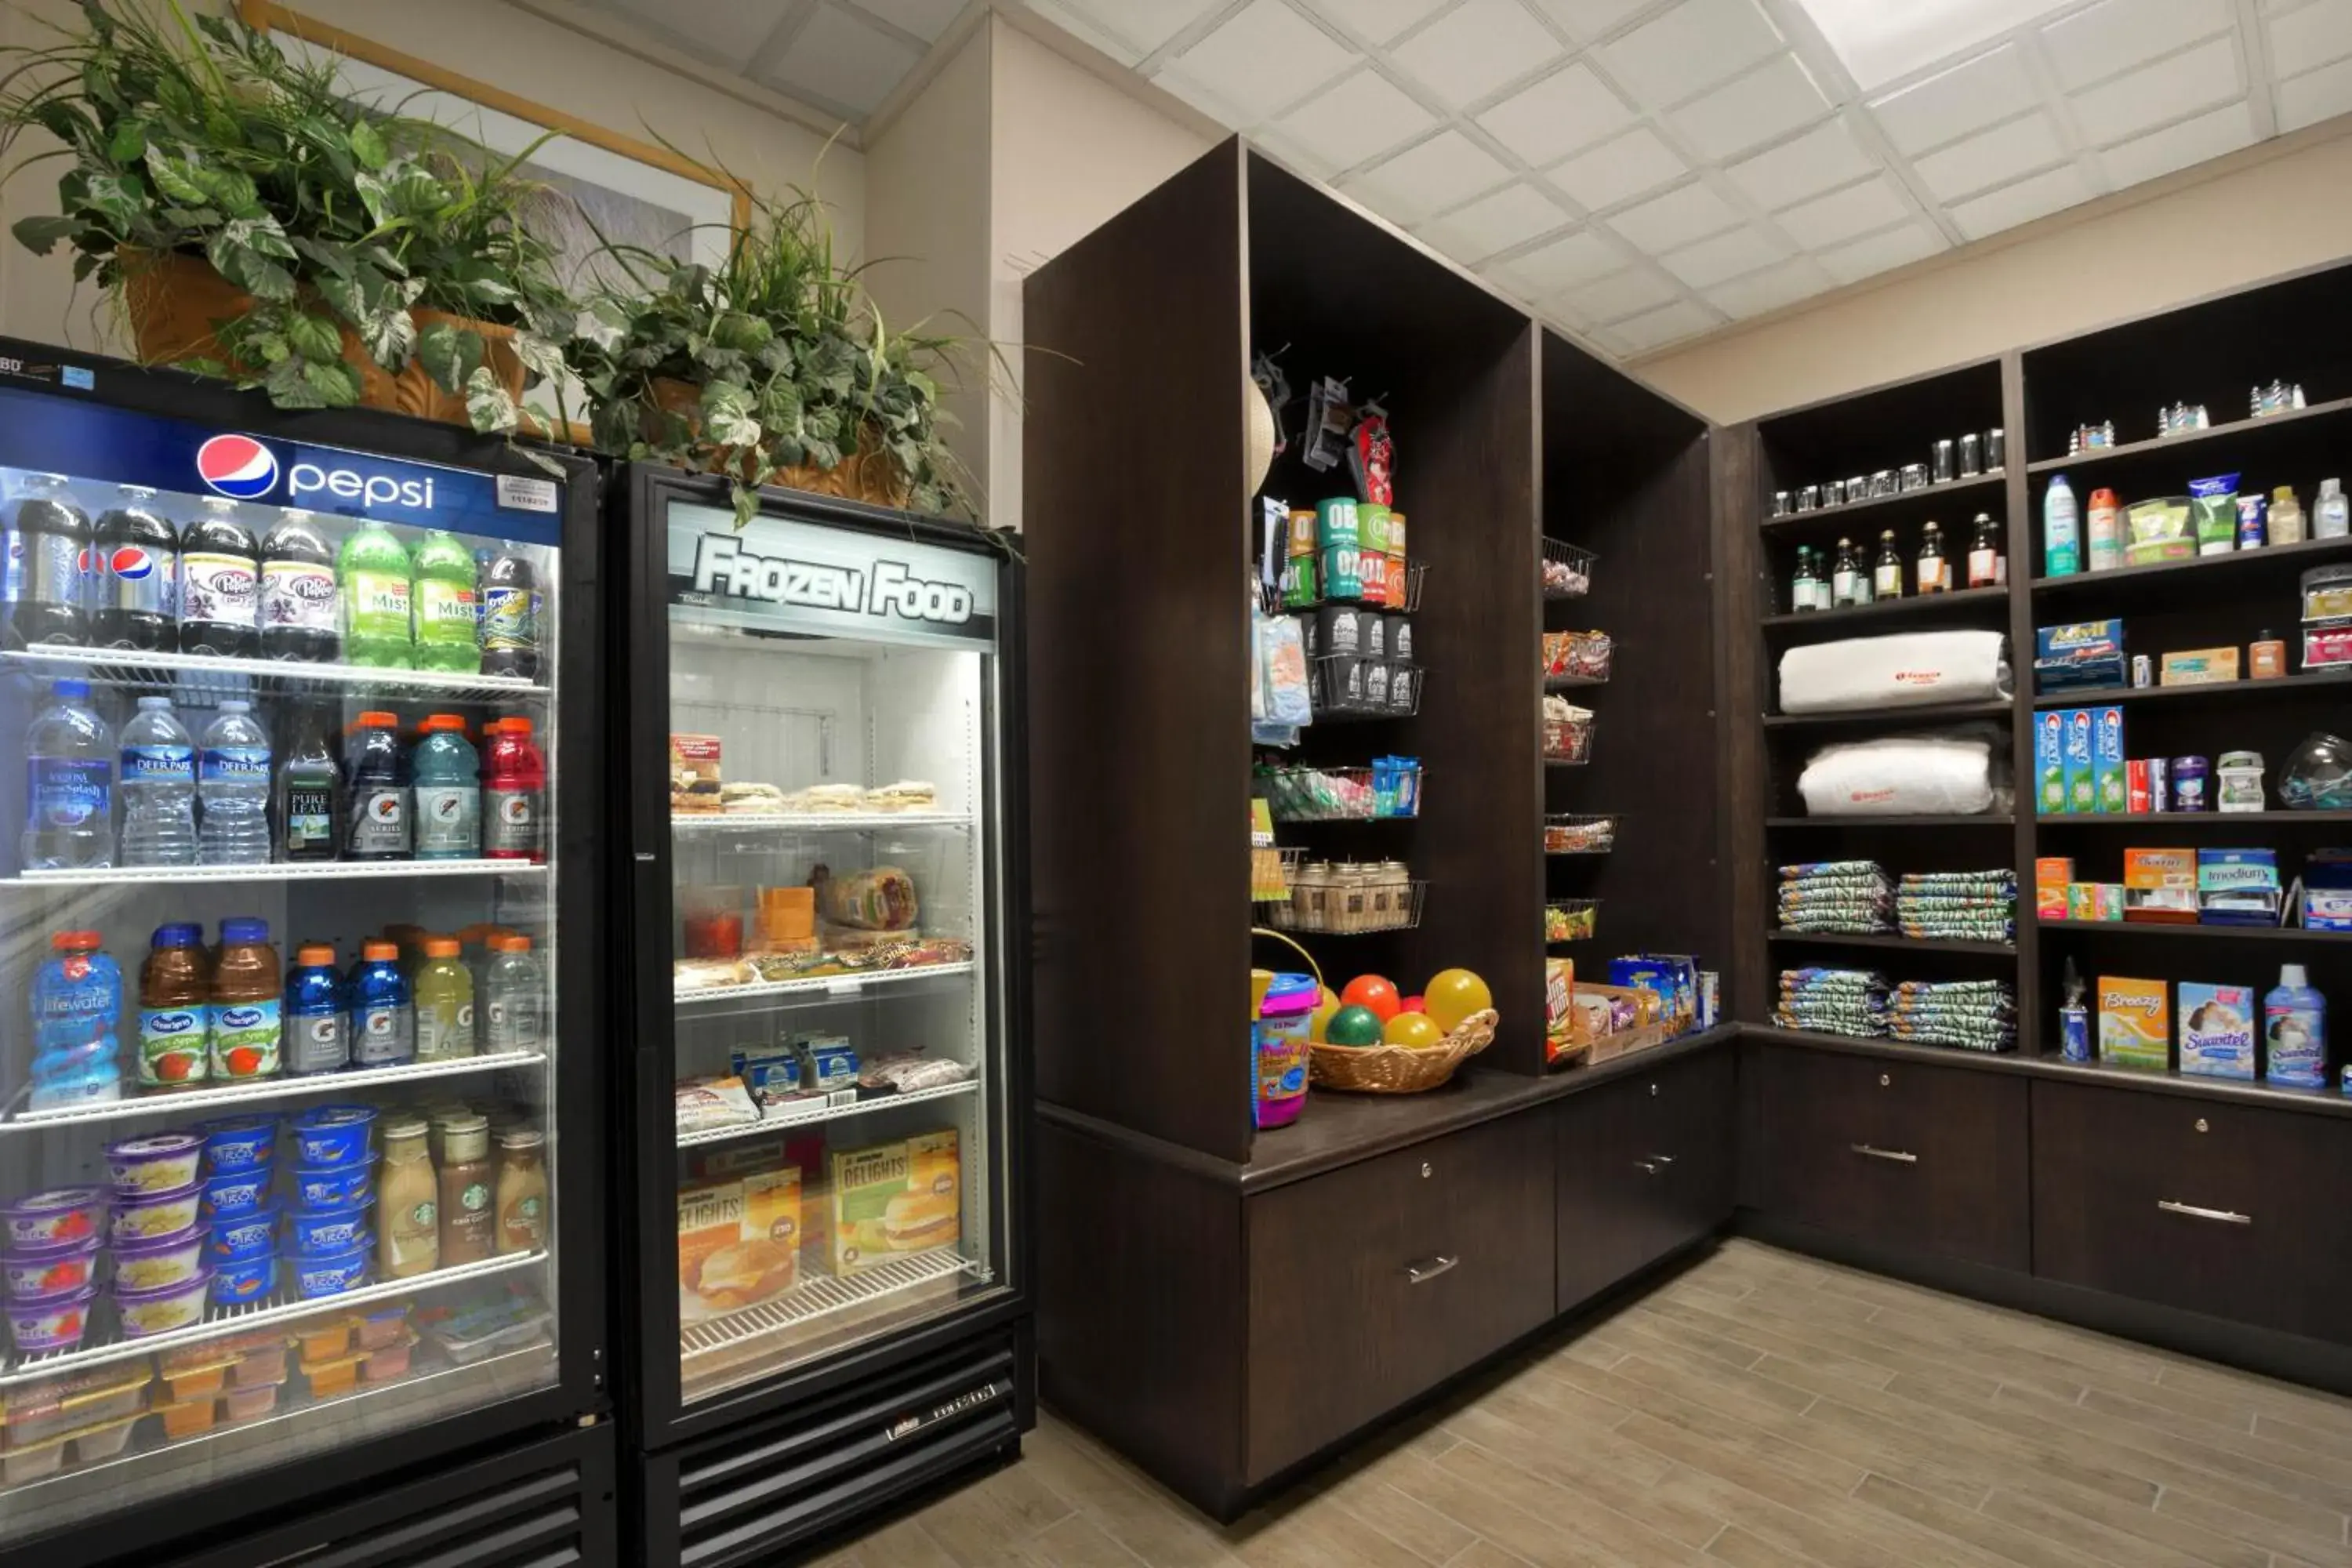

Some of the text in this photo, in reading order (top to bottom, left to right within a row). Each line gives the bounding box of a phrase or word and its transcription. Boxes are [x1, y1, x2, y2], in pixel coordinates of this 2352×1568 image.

[288, 463, 435, 509] pepsi
[694, 531, 974, 625] FROZEN FOOD
[844, 1156, 906, 1189] DELIGHTS
[678, 1198, 739, 1229] ELIGHTS
